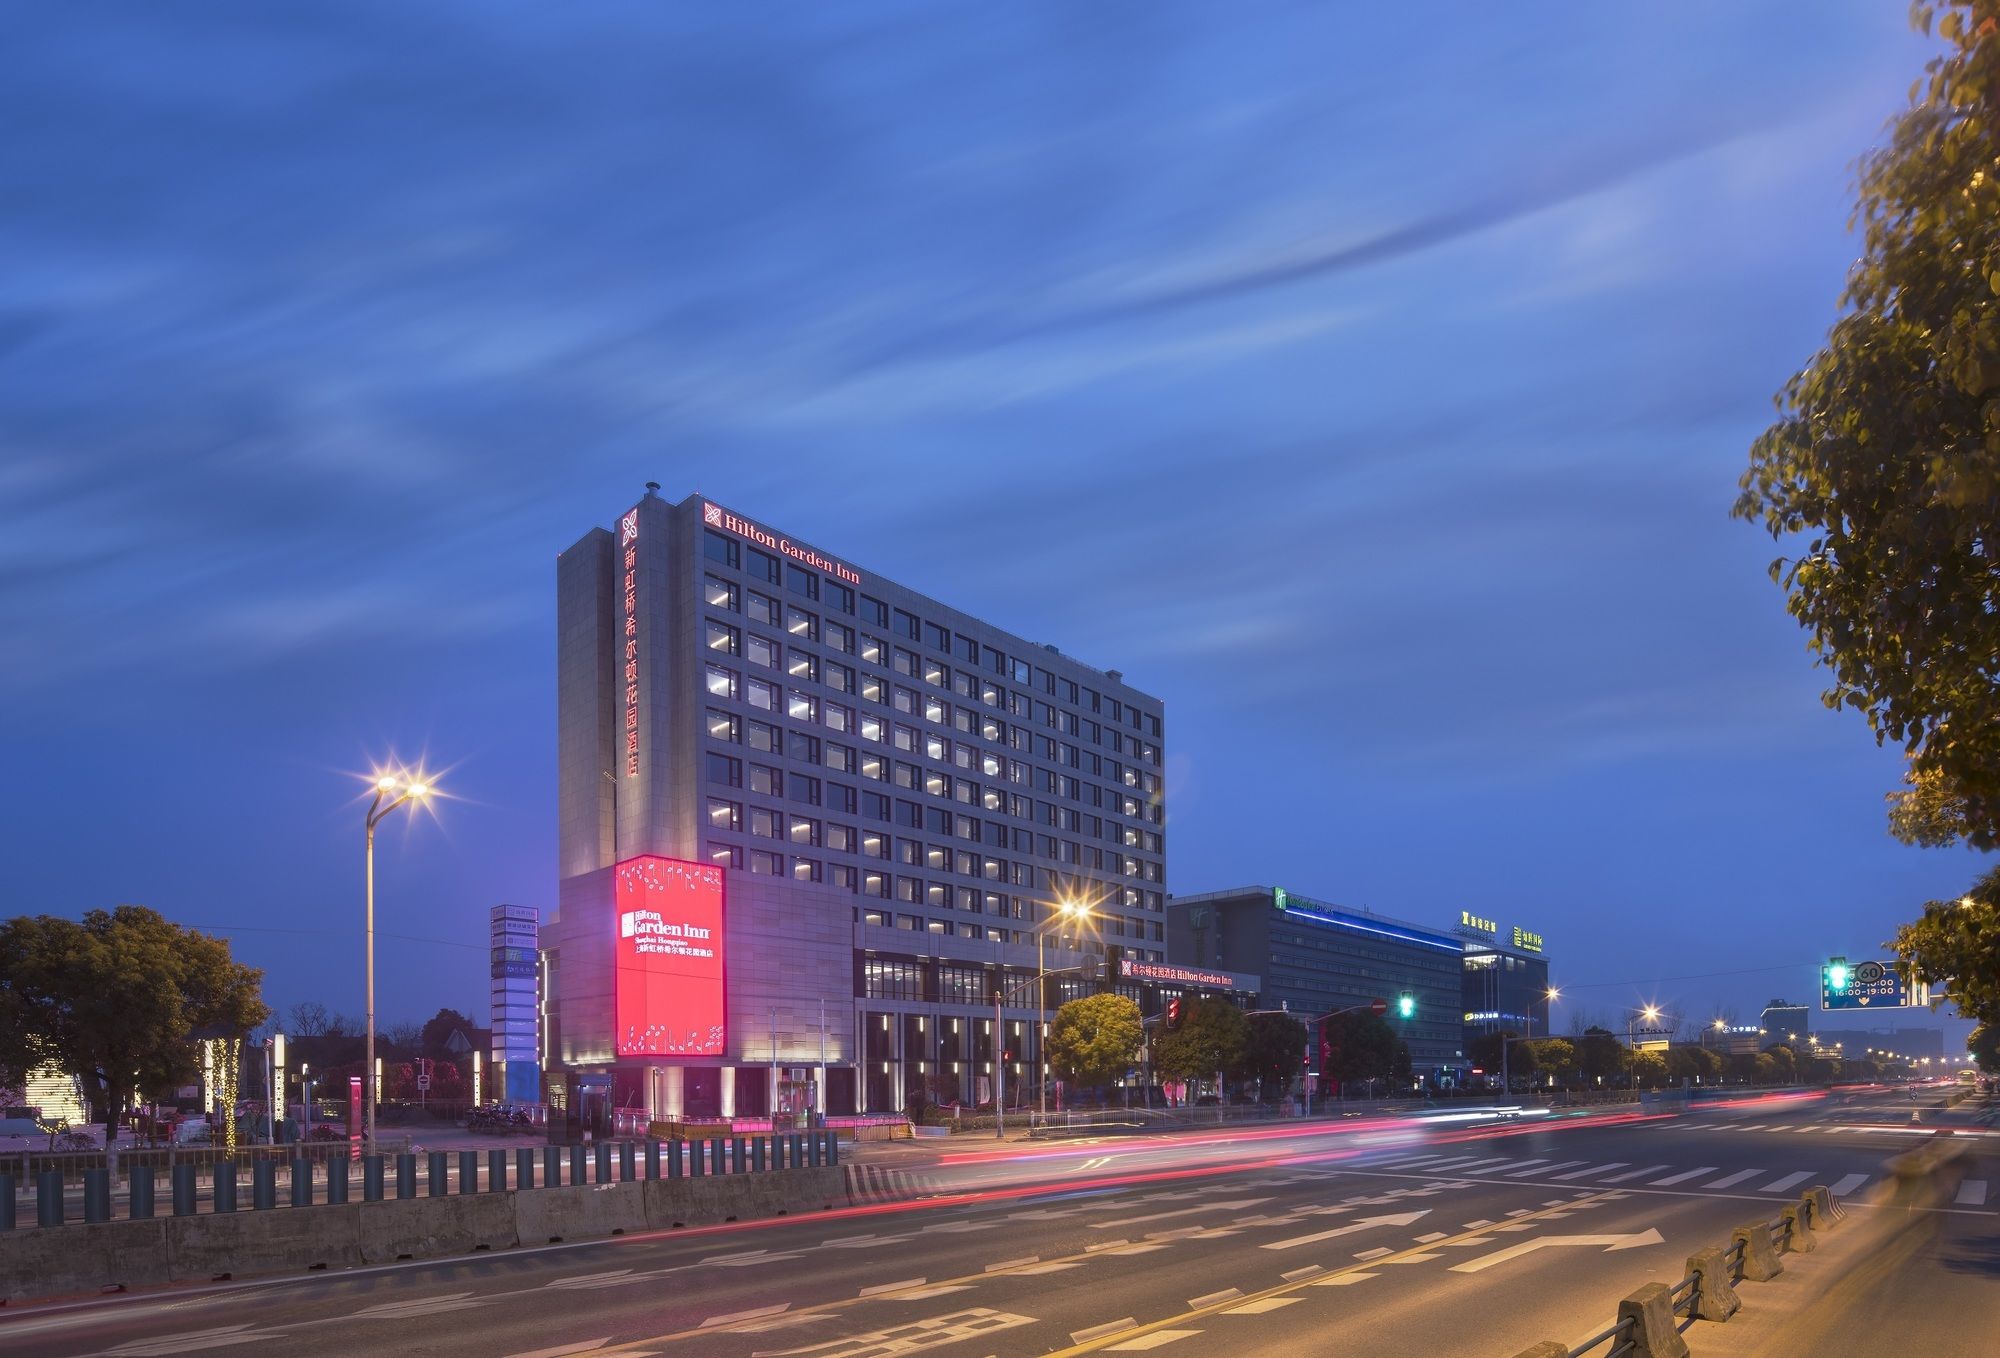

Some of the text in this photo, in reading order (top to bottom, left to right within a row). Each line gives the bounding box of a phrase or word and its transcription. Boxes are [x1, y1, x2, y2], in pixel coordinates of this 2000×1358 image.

[724, 513, 860, 585] Hilton Garden Inn
[635, 921, 709, 938] Garden Inn
[1177, 969, 1198, 981] Hilton
[1199, 973, 1221, 984] Garden
[1222, 975, 1233, 985] Inn
[1861, 967, 1878, 979] 60
[1835, 988, 1893, 996] 16:00-19:00
